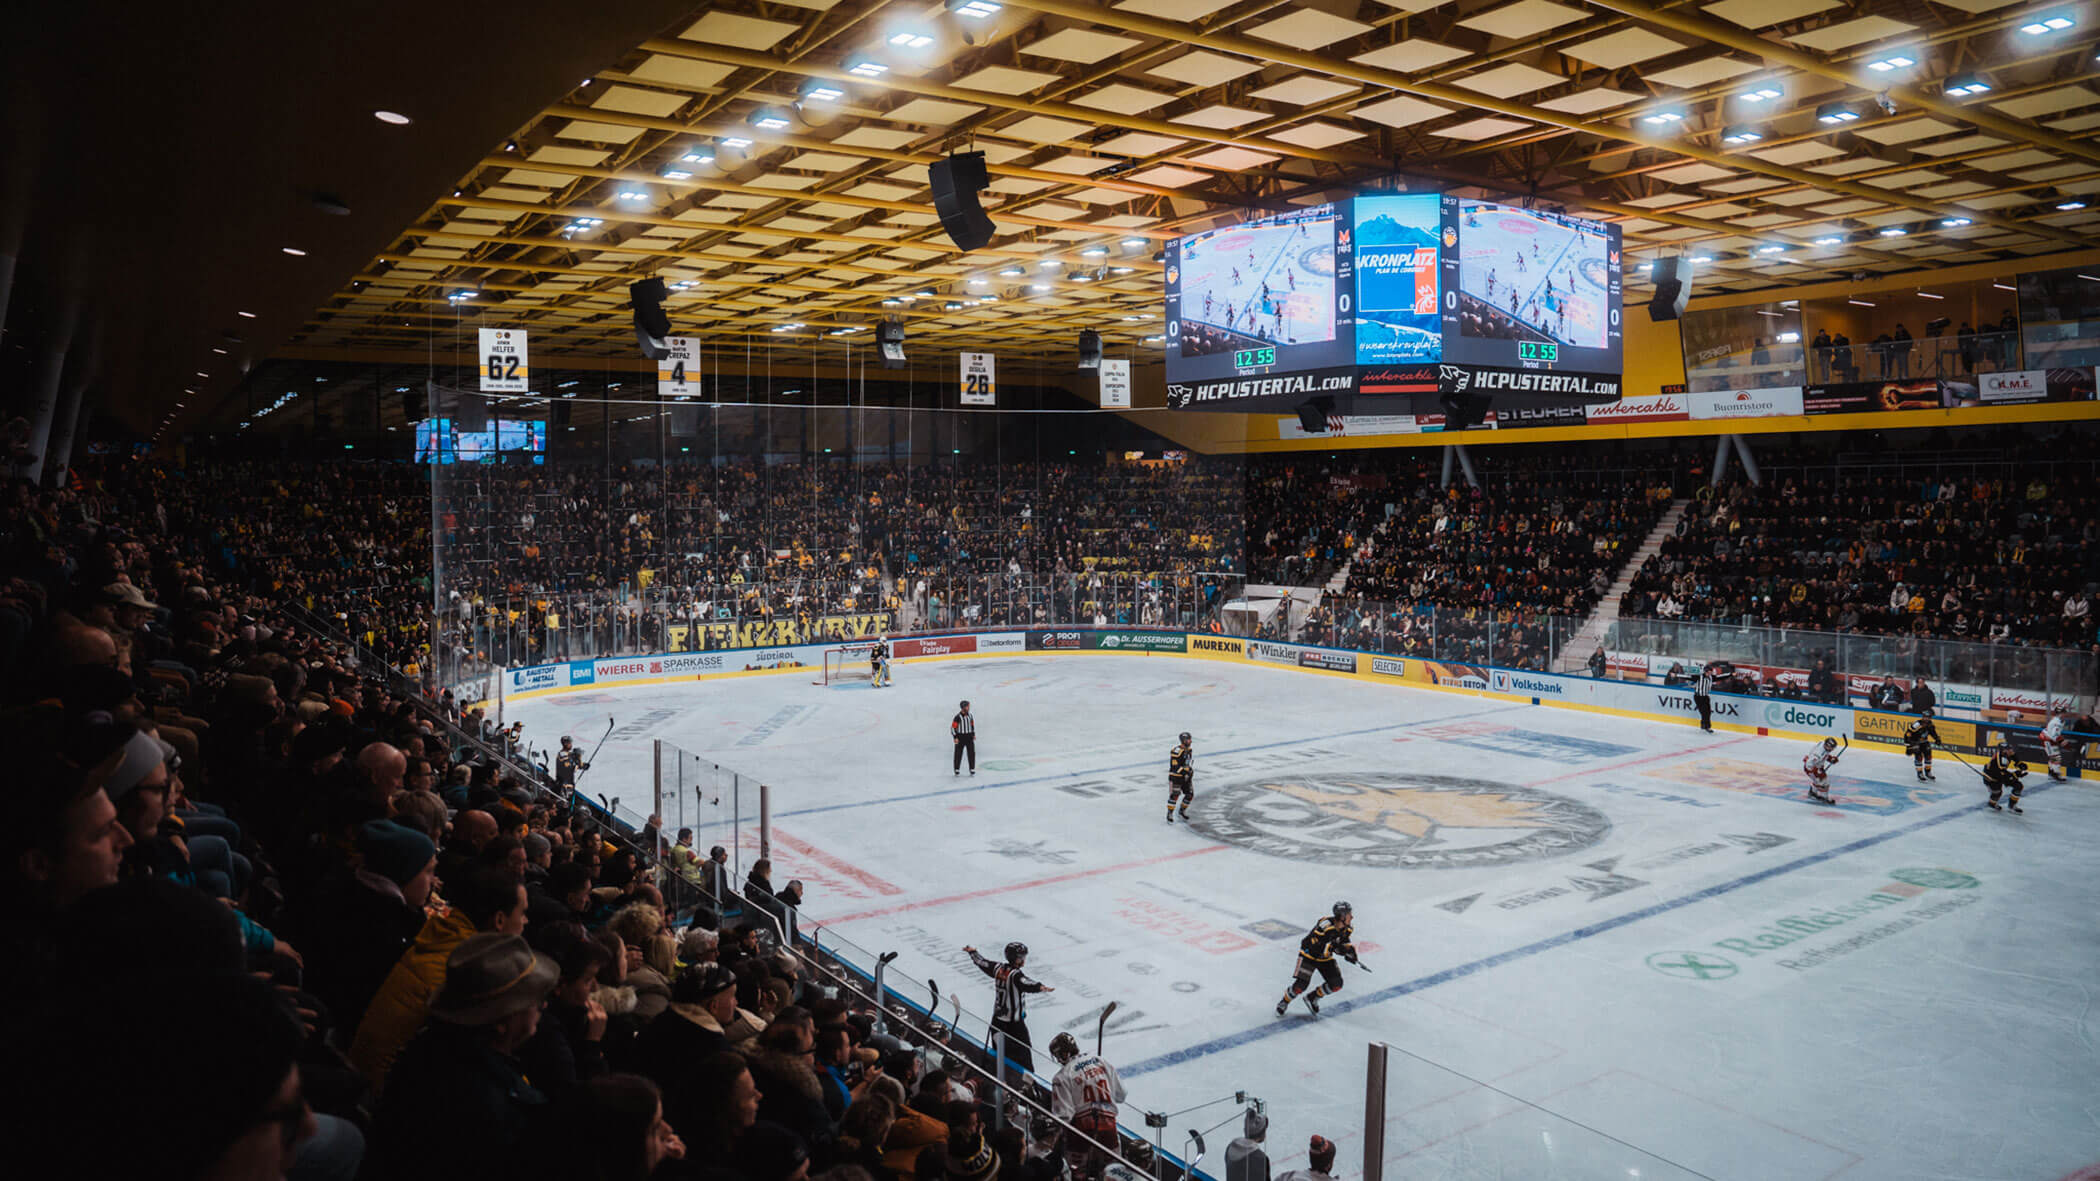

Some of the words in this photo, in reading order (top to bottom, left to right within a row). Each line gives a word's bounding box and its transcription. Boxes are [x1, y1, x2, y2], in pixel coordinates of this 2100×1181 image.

[1359, 253, 1435, 268] KRONPLATZ
[1339, 294, 1351, 312] 0
[1446, 291, 1457, 309] 0
[1610, 309, 1619, 325] 0
[1169, 321, 1178, 337] 0
[1236, 352, 1252, 367] 12
[1257, 349, 1274, 365] 55
[1520, 343, 1535, 358] 12
[1541, 345, 1556, 360] 55
[488, 355, 519, 380] 62
[672, 360, 685, 385] 4
[967, 374, 989, 396] 26
[1197, 375, 1352, 401] HCPUSTERTAL.COM
[1474, 371, 1618, 395] HCPUSTERTAL.COM
[1592, 397, 1681, 416] intercable
[1714, 402, 1773, 412] Buonristoro
[1132, 636, 1185, 645] AUSSERHOFER
[1193, 639, 1242, 653] MUREXIN
[922, 646, 951, 655] Fairplay
[1260, 643, 1297, 660] Winkler
[597, 663, 645, 676] WIERER
[663, 656, 724, 669] SPARKASSE
[1374, 660, 1402, 673] SELECTRA
[526, 666, 557, 677] BAUSTOFF
[532, 674, 555, 683] METALL
[572, 668, 592, 679] BMI
[1511, 677, 1562, 694] Volksbank
[1658, 695, 1739, 717] VITRUX
[1784, 706, 1836, 728] decor
